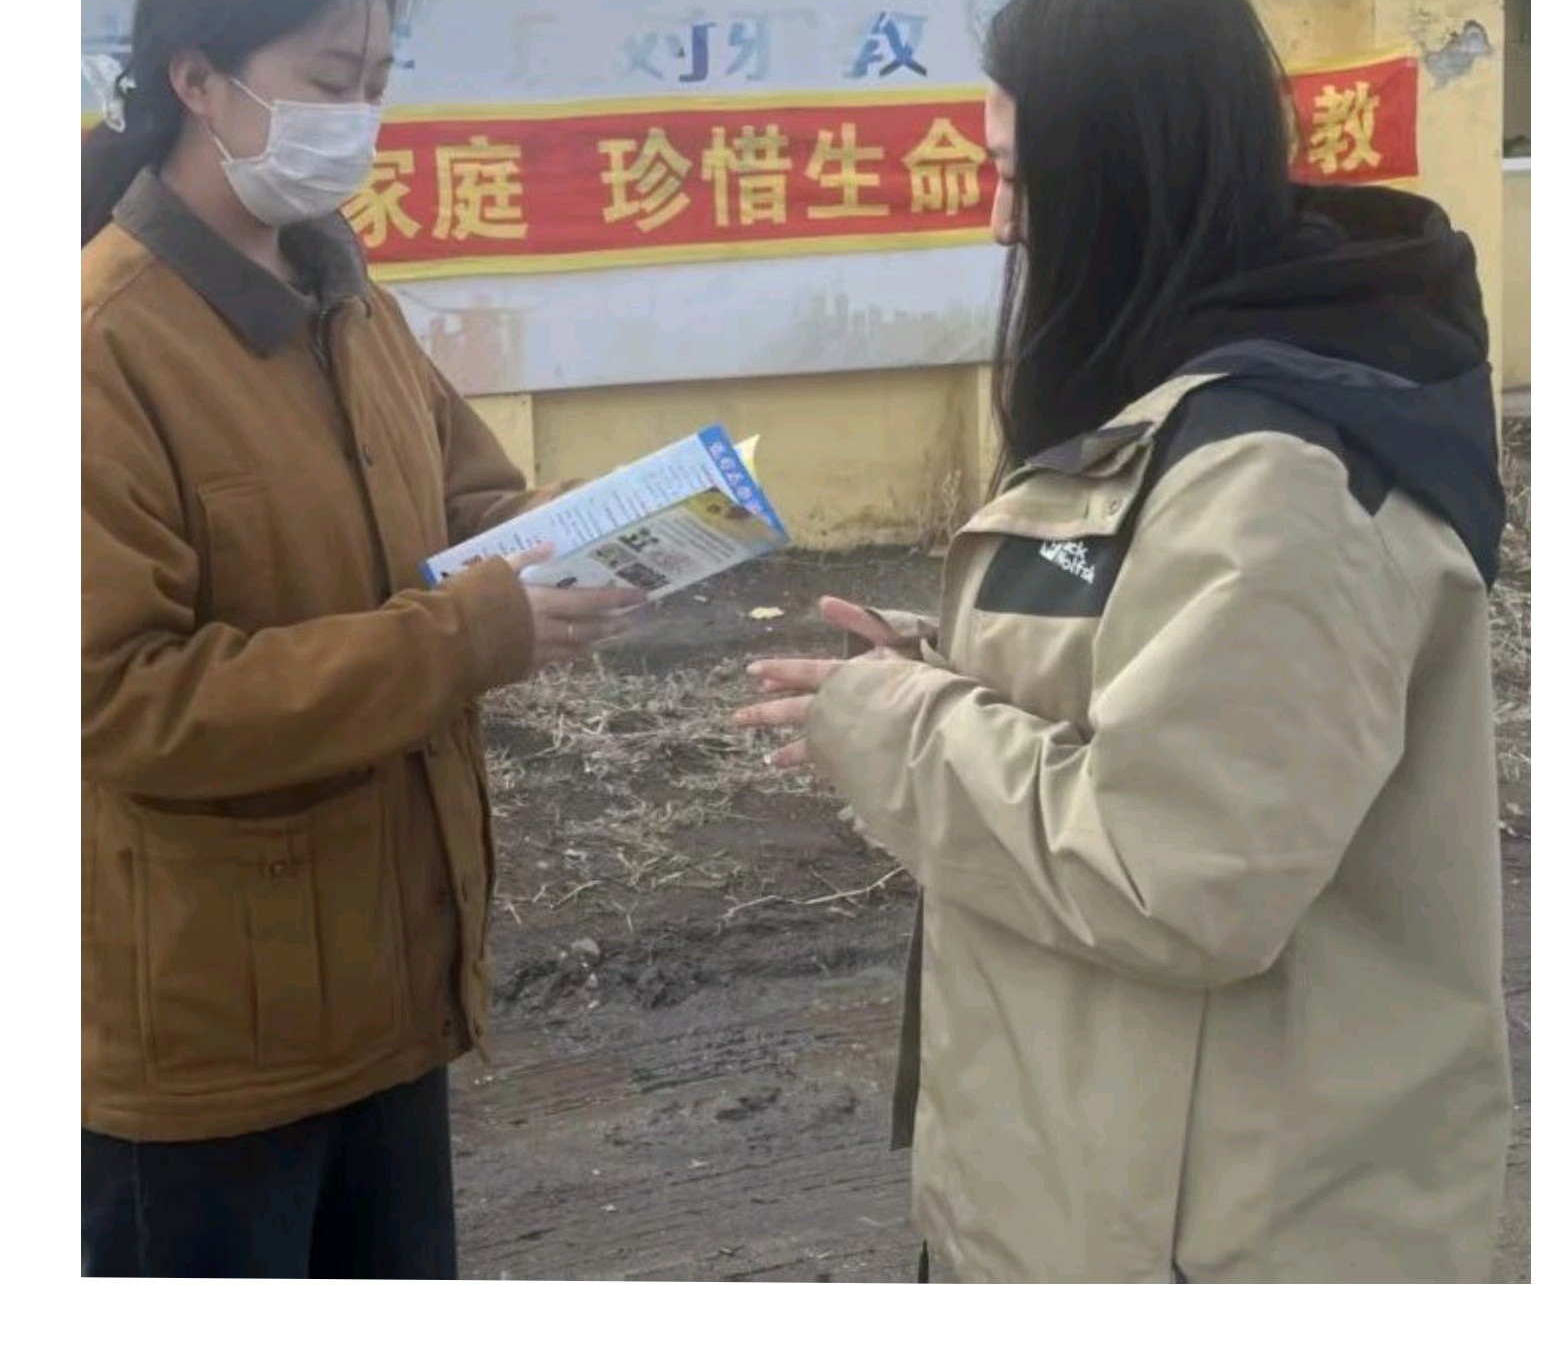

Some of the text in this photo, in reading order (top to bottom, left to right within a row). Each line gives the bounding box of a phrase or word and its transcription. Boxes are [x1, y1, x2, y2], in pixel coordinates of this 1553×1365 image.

[341, 81, 1384, 249] 家庭 珍惜生命 教
